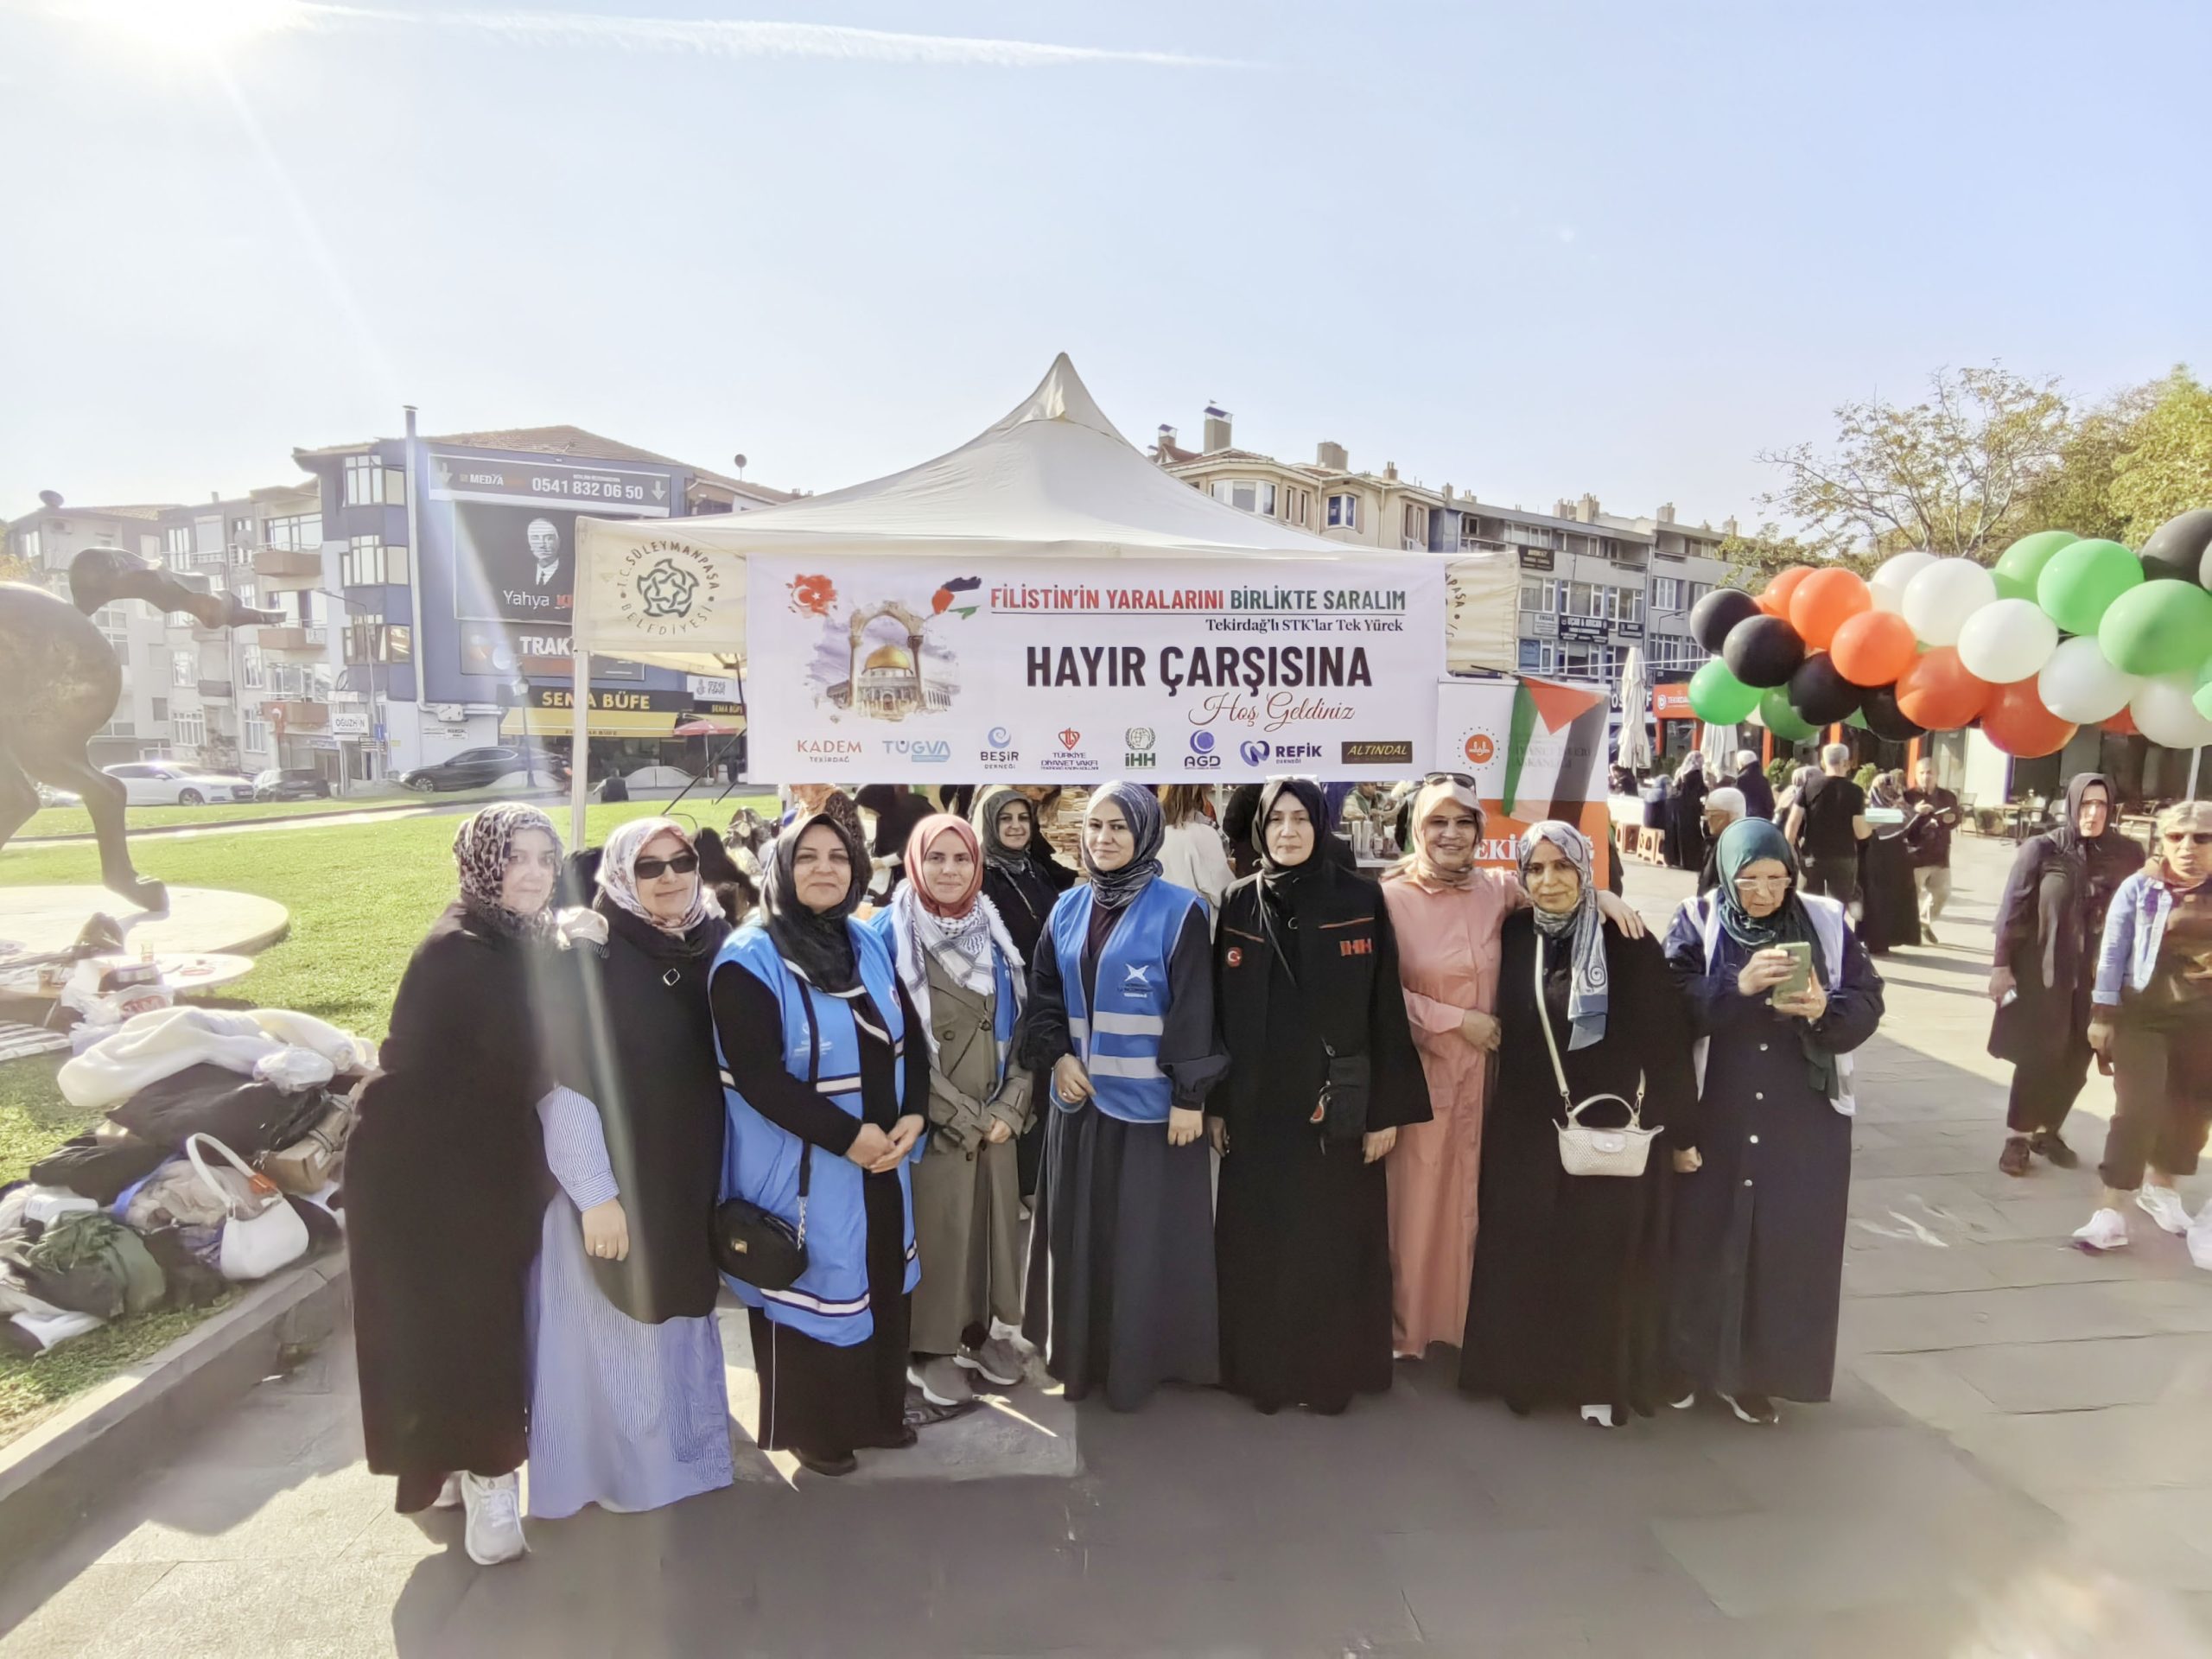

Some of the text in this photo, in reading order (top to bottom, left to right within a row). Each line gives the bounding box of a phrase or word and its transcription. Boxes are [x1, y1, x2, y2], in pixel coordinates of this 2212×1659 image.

[531, 477, 569, 493] 0541
[572, 480, 600, 496] 832
[603, 483, 622, 498] 06
[626, 485, 644, 499] 50
[503, 589, 550, 610] Yahya
[990, 583, 1407, 611] FİLİSTİN'İN YARALARINI BİRLİKTE SARALIM
[1281, 618, 1333, 632] STK'lar
[1335, 618, 1362, 632] Tek
[1363, 618, 1404, 632] Yürek
[519, 636, 575, 656] TRAK
[1026, 645, 1373, 697] HAYIR ÇARŞISINA
[602, 691, 651, 709] BÜFE
[1188, 691, 1356, 733] Hoş Geldiniz
[797, 740, 862, 753] KADEM
[881, 740, 950, 754] TÜGVA
[1275, 742, 1323, 758] REFİK
[1347, 744, 1408, 756] ALTINDAL
[1184, 755, 1221, 767] AGD
